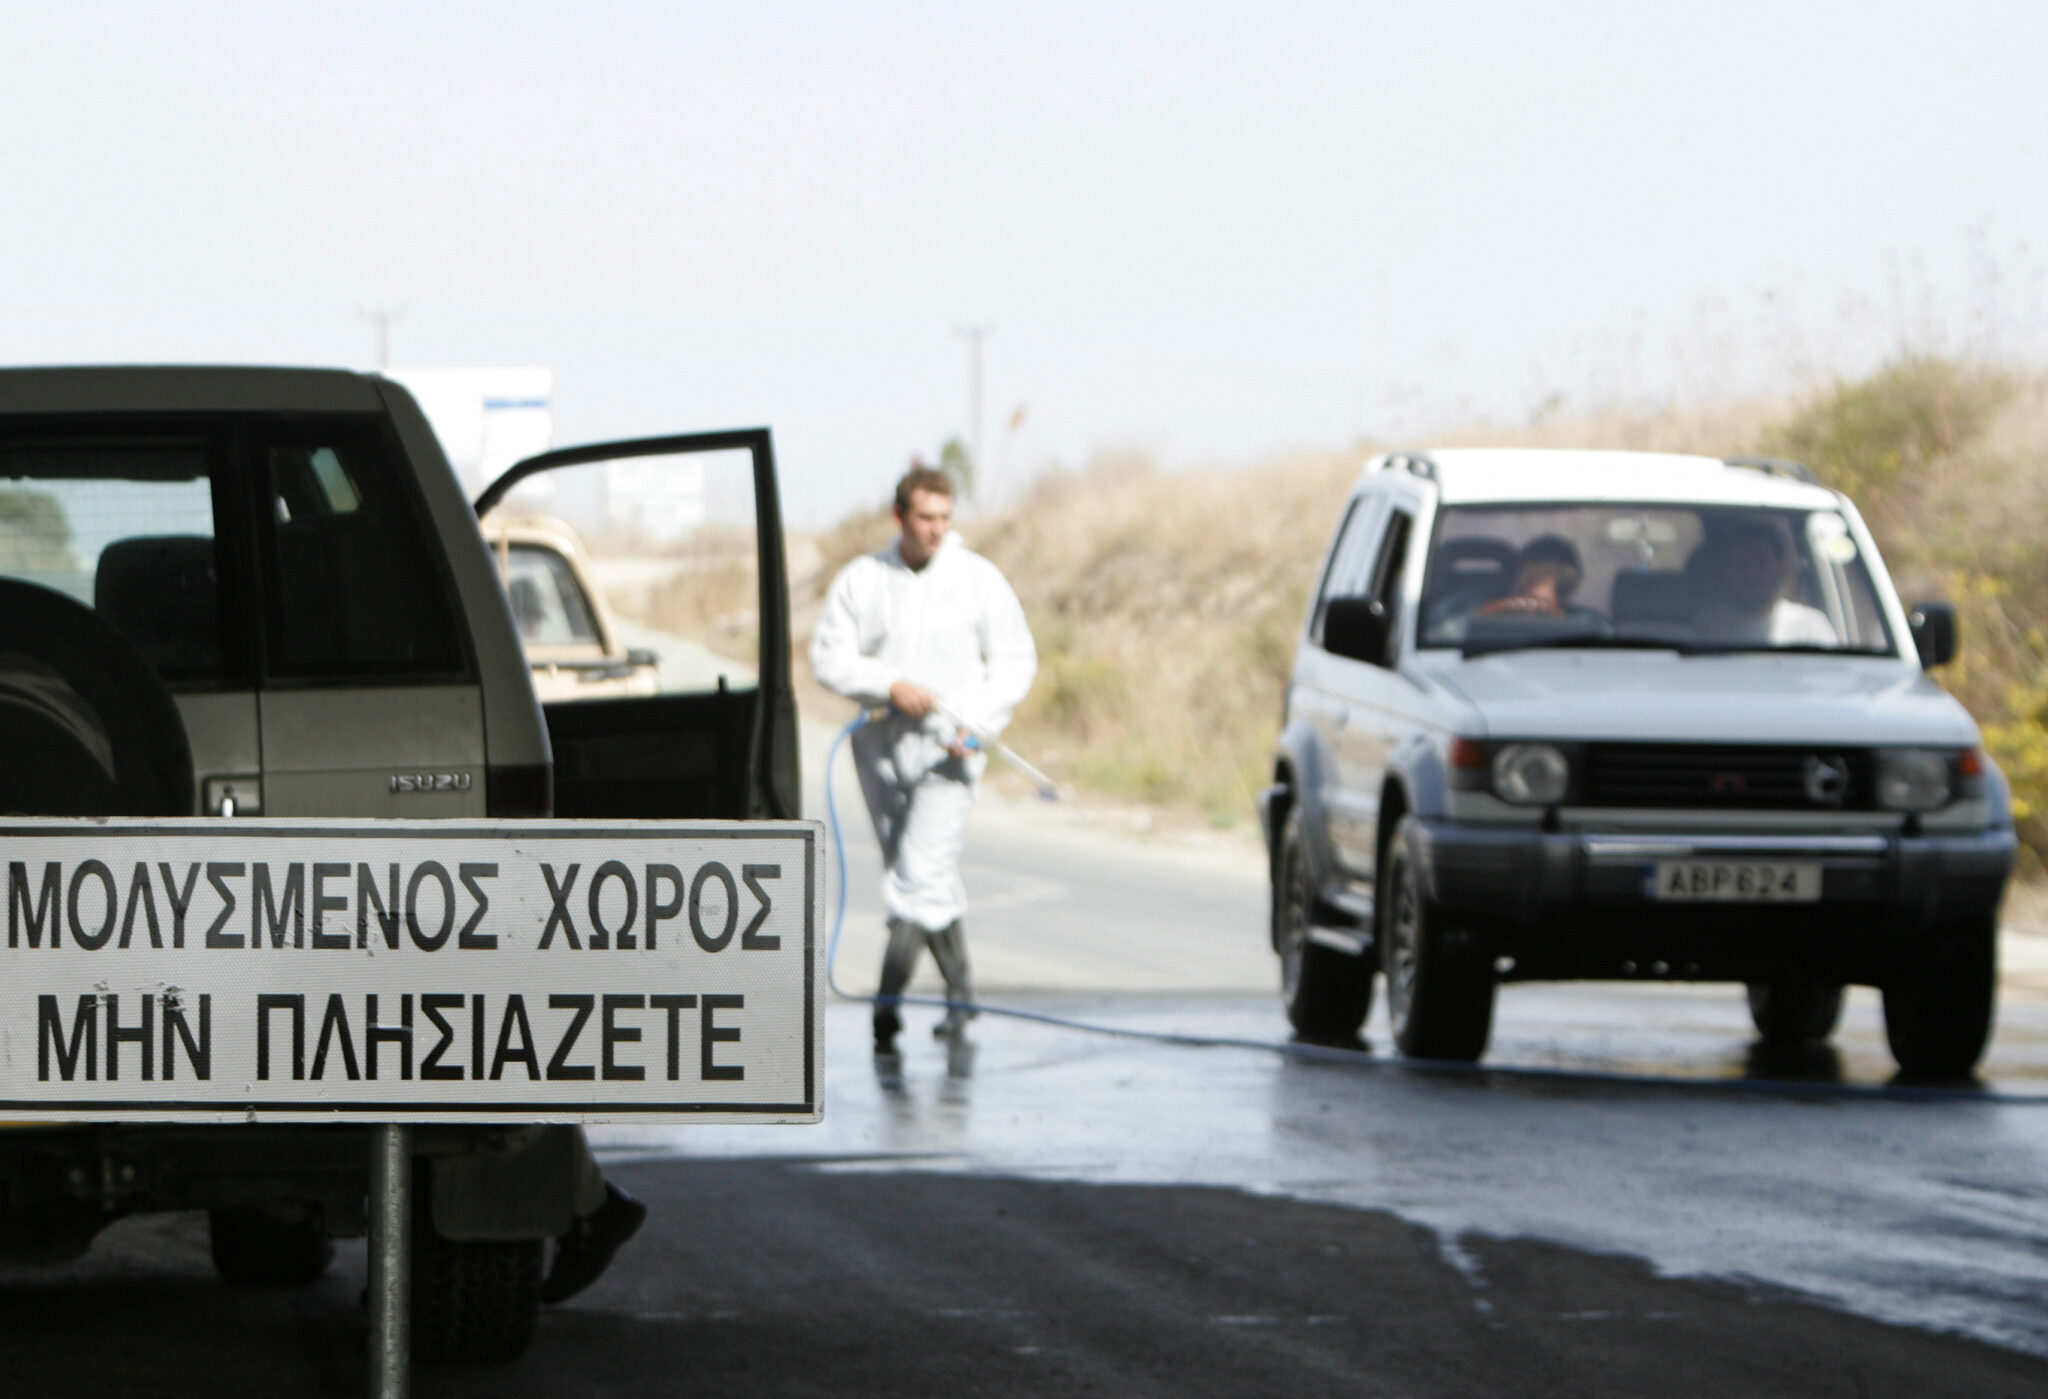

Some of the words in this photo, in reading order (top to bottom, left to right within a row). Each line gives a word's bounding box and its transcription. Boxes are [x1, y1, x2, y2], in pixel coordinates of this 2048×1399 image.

[390, 773, 470, 793] ISUZU
[8, 859, 499, 953] ΜΟΛΥΣΜΕΝΟΣ
[537, 860, 781, 953] ΧΩΡΟΣ
[37, 992, 211, 1081] ΜΗΝ
[257, 993, 744, 1081] ΠΛΗΣΙΑΖΕΤΕ
